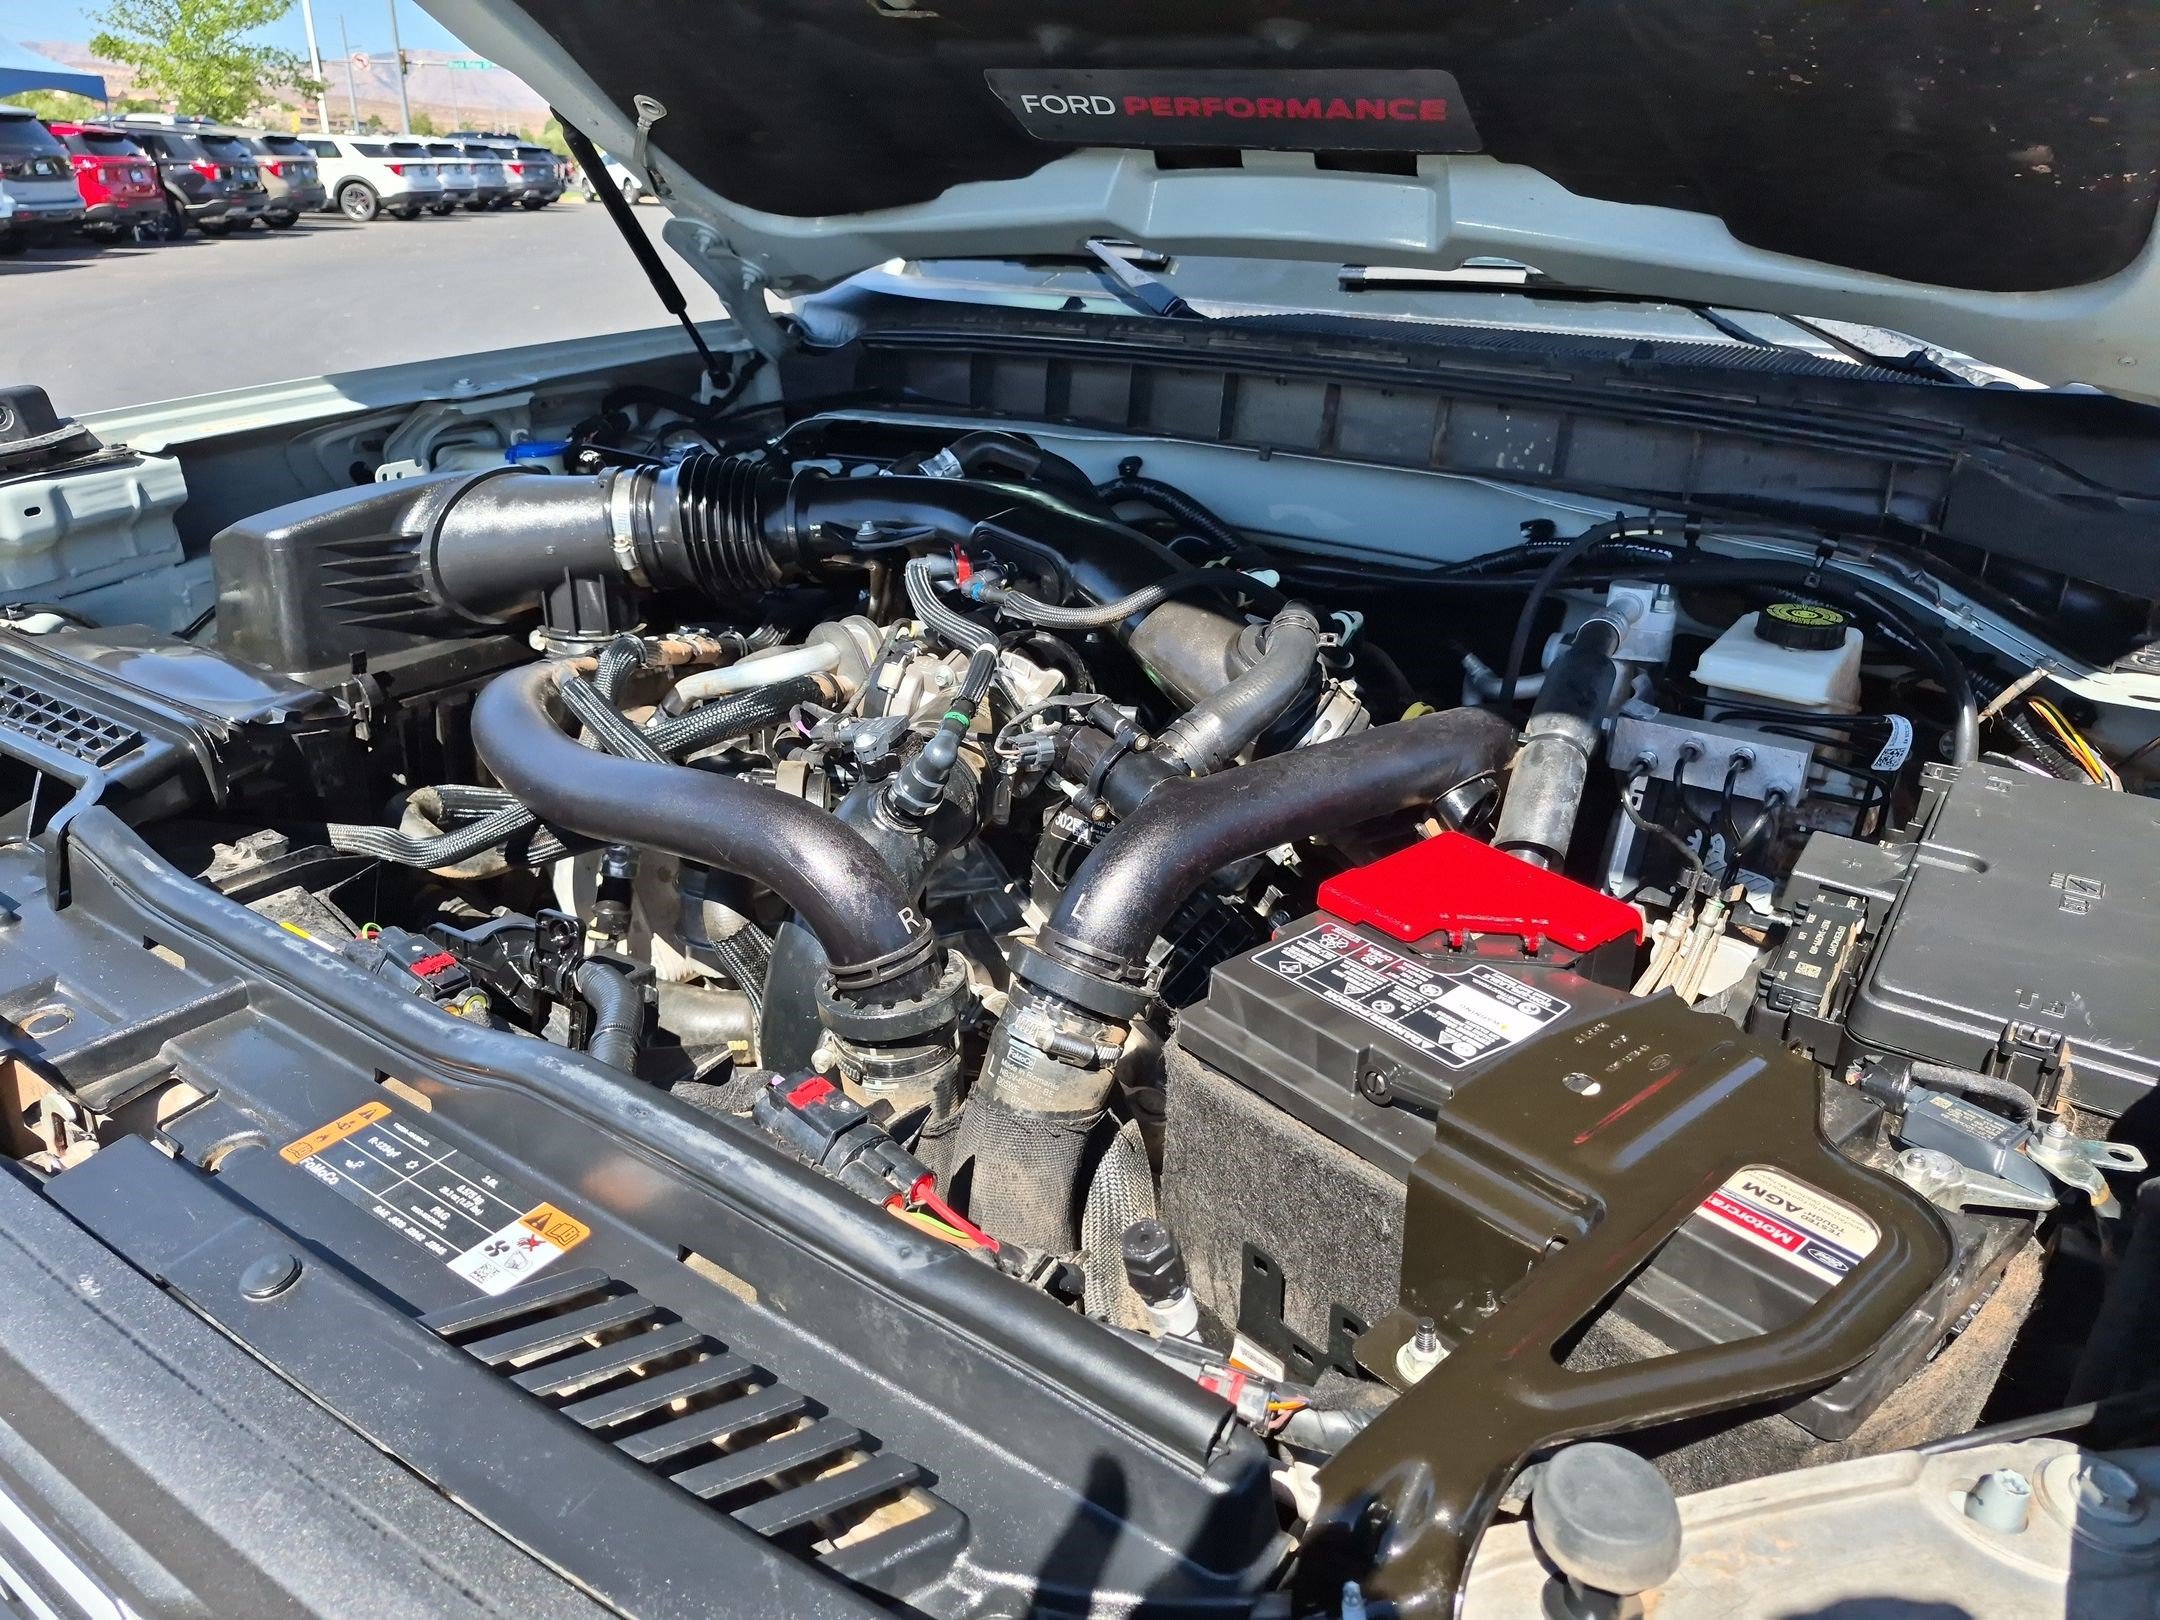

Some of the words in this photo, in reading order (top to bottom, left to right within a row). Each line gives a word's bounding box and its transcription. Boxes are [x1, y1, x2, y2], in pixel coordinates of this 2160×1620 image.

[1020, 94, 1116, 116] FORD
[1122, 95, 1447, 121] PERFORMANCE
[1071, 893, 1084, 919] L
[898, 906, 920, 934] R
[1361, 957, 1376, 966] DO
[1364, 953, 1384, 963] NOT
[1323, 990, 1424, 1044] DANGER/POISON
[368, 1136, 401, 1158] R-1234yf
[299, 1157, 339, 1185] FoMoCo
[1741, 1181, 1803, 1213] AGM
[373, 1205, 391, 1218] SAE
[430, 1206, 451, 1220] PAG
[1806, 1211, 1845, 1233] TOUGH
[1800, 1214, 1841, 1237] TESTED
